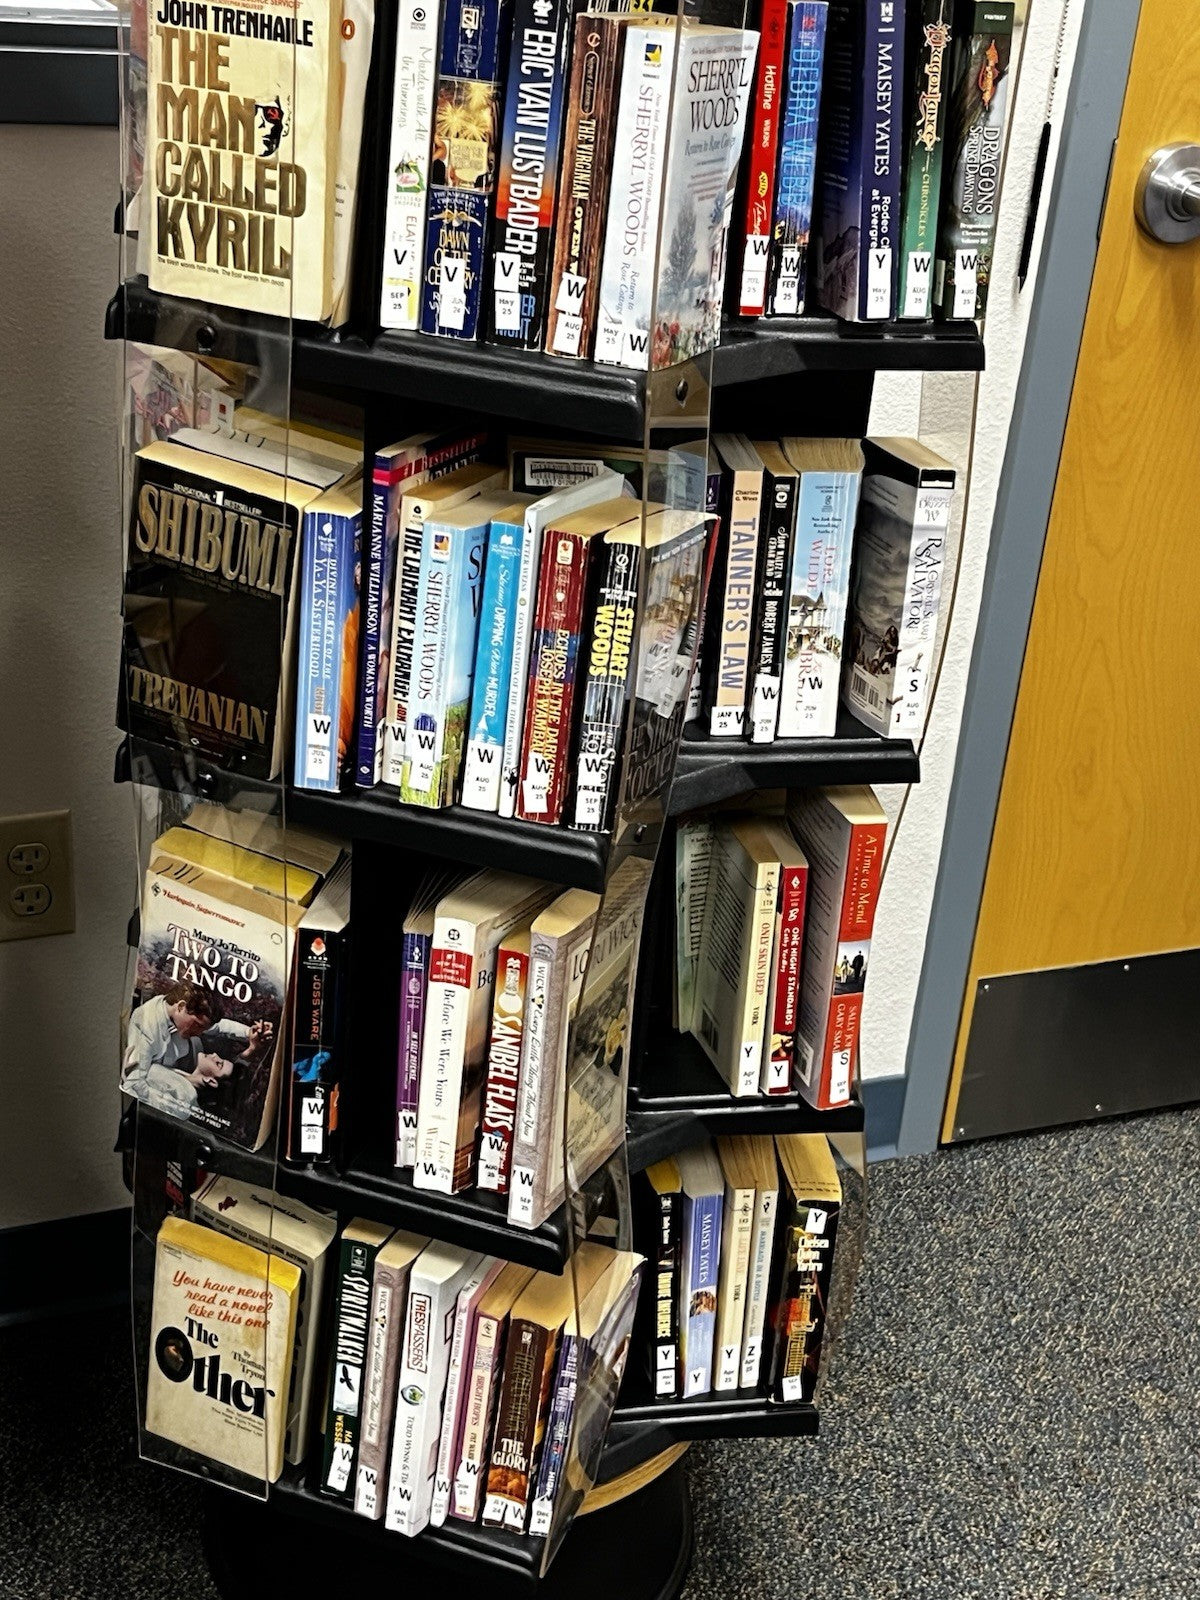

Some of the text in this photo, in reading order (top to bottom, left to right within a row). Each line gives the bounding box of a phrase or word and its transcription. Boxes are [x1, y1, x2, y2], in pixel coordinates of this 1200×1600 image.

[157, 0, 314, 47] JOHN TRENHAILE
[156, 25, 231, 92] THE
[520, 27, 557, 79] ERIC
[688, 58, 748, 97] SHERRYL
[762, 64, 777, 111] Hotline
[156, 82, 257, 156] MAN
[515, 82, 554, 127] VAN
[690, 95, 741, 132] WOODS
[873, 43, 894, 177] MAISEY YATES
[629, 85, 655, 176] SHERRYL
[779, 49, 820, 207] DEBRA WEBB
[156, 140, 307, 218] CALLED
[570, 119, 596, 258] THE VIRGINIAN OWEN
[758, 172, 768, 196] WIN
[976, 126, 1000, 215] DRAGONS
[504, 131, 548, 255] LUSTBADER
[918, 174, 931, 238] CHRONICLES
[623, 182, 644, 257] WOODS
[868, 189, 880, 249] at Evergre
[880, 196, 892, 231] Rodeo
[157, 196, 292, 279] KYRIL
[501, 260, 514, 277] V
[785, 257, 800, 272] W
[565, 321, 580, 331] AUG
[136, 483, 292, 596] SHIBUMI
[403, 527, 423, 553] THE
[523, 538, 532, 565] PETER
[765, 537, 777, 577] CEDAR BEND
[777, 526, 788, 549] SLOW
[327, 559, 338, 596] DIVINE
[520, 566, 529, 592] WEISS
[775, 550, 785, 570] WALTZ
[806, 538, 824, 593] WILDE
[821, 546, 837, 585] LORI
[494, 565, 512, 606] Skinny
[720, 517, 757, 690] TANNER'S LAW
[904, 547, 929, 635] SALVATORE
[325, 600, 337, 644] SECRETS
[362, 494, 385, 728] MARIANNE WILLIAMSON A WOMAN'S WORTH
[490, 606, 507, 647] DIPPING
[417, 570, 443, 701] SHERRYL WOODS
[512, 612, 526, 674] CONVERSATION
[588, 604, 616, 678] WOODS
[610, 606, 635, 680] STUART
[760, 600, 778, 665] ROBERT JAMES
[322, 663, 332, 679] THE
[540, 644, 555, 686] JOSEPH
[552, 628, 570, 679] ECHOES
[129, 665, 268, 744] TREVANIAN
[484, 676, 500, 717] MURDER
[510, 692, 519, 707] THE
[551, 682, 564, 698] IN
[909, 679, 918, 692] S
[313, 719, 331, 735] W
[397, 704, 408, 722] JON
[508, 709, 518, 734] THREE
[548, 698, 564, 724] THE
[719, 721, 729, 729] 25
[865, 834, 878, 845] A
[861, 846, 877, 874] Time
[859, 878, 869, 888] to
[162, 889, 245, 928] Harlequin Superromance
[854, 892, 871, 924] Mend
[166, 922, 259, 982] TWO TO
[192, 928, 261, 962] Mary Jo Territo
[781, 927, 791, 947] Cathy
[165, 953, 252, 1003] TANGO
[751, 923, 771, 1026] ONLY SKIN DEEP YORK
[785, 926, 800, 1025] ONE NIGHT STANDARDS
[310, 974, 322, 1041] JOSS WARE
[441, 989, 456, 1025] Before
[835, 1003, 847, 1029] GARY
[845, 1005, 858, 1032] SALLY
[439, 1028, 453, 1045] We
[488, 1013, 523, 1081] SANIBEL
[523, 966, 546, 1137] WICK Every Little Thing About You
[437, 1048, 450, 1076] Were
[774, 1065, 783, 1077] Y
[840, 1053, 849, 1066] S
[308, 1102, 324, 1114] W
[434, 1078, 449, 1107] Yours
[484, 1083, 517, 1132] FLATS
[699, 1213, 713, 1284] MAISEY YATES
[172, 1270, 274, 1301] You have never
[185, 1290, 273, 1315] read a novel
[378, 1290, 388, 1314] WICK
[188, 1304, 270, 1330] like this one
[336, 1273, 370, 1365] SPIRITWALKER
[656, 1272, 674, 1339] UNDUE INFLUENCE
[184, 1316, 219, 1349] The
[412, 1299, 428, 1368] TRESPASSERS
[748, 1346, 756, 1356] Z
[155, 1326, 276, 1420] Other
[662, 1350, 671, 1361] Y
[725, 1349, 734, 1360] Y
[470, 1375, 486, 1426] BRIGHT HOPES
[492, 1451, 528, 1472] GLORY
[500, 1437, 525, 1455] THE
